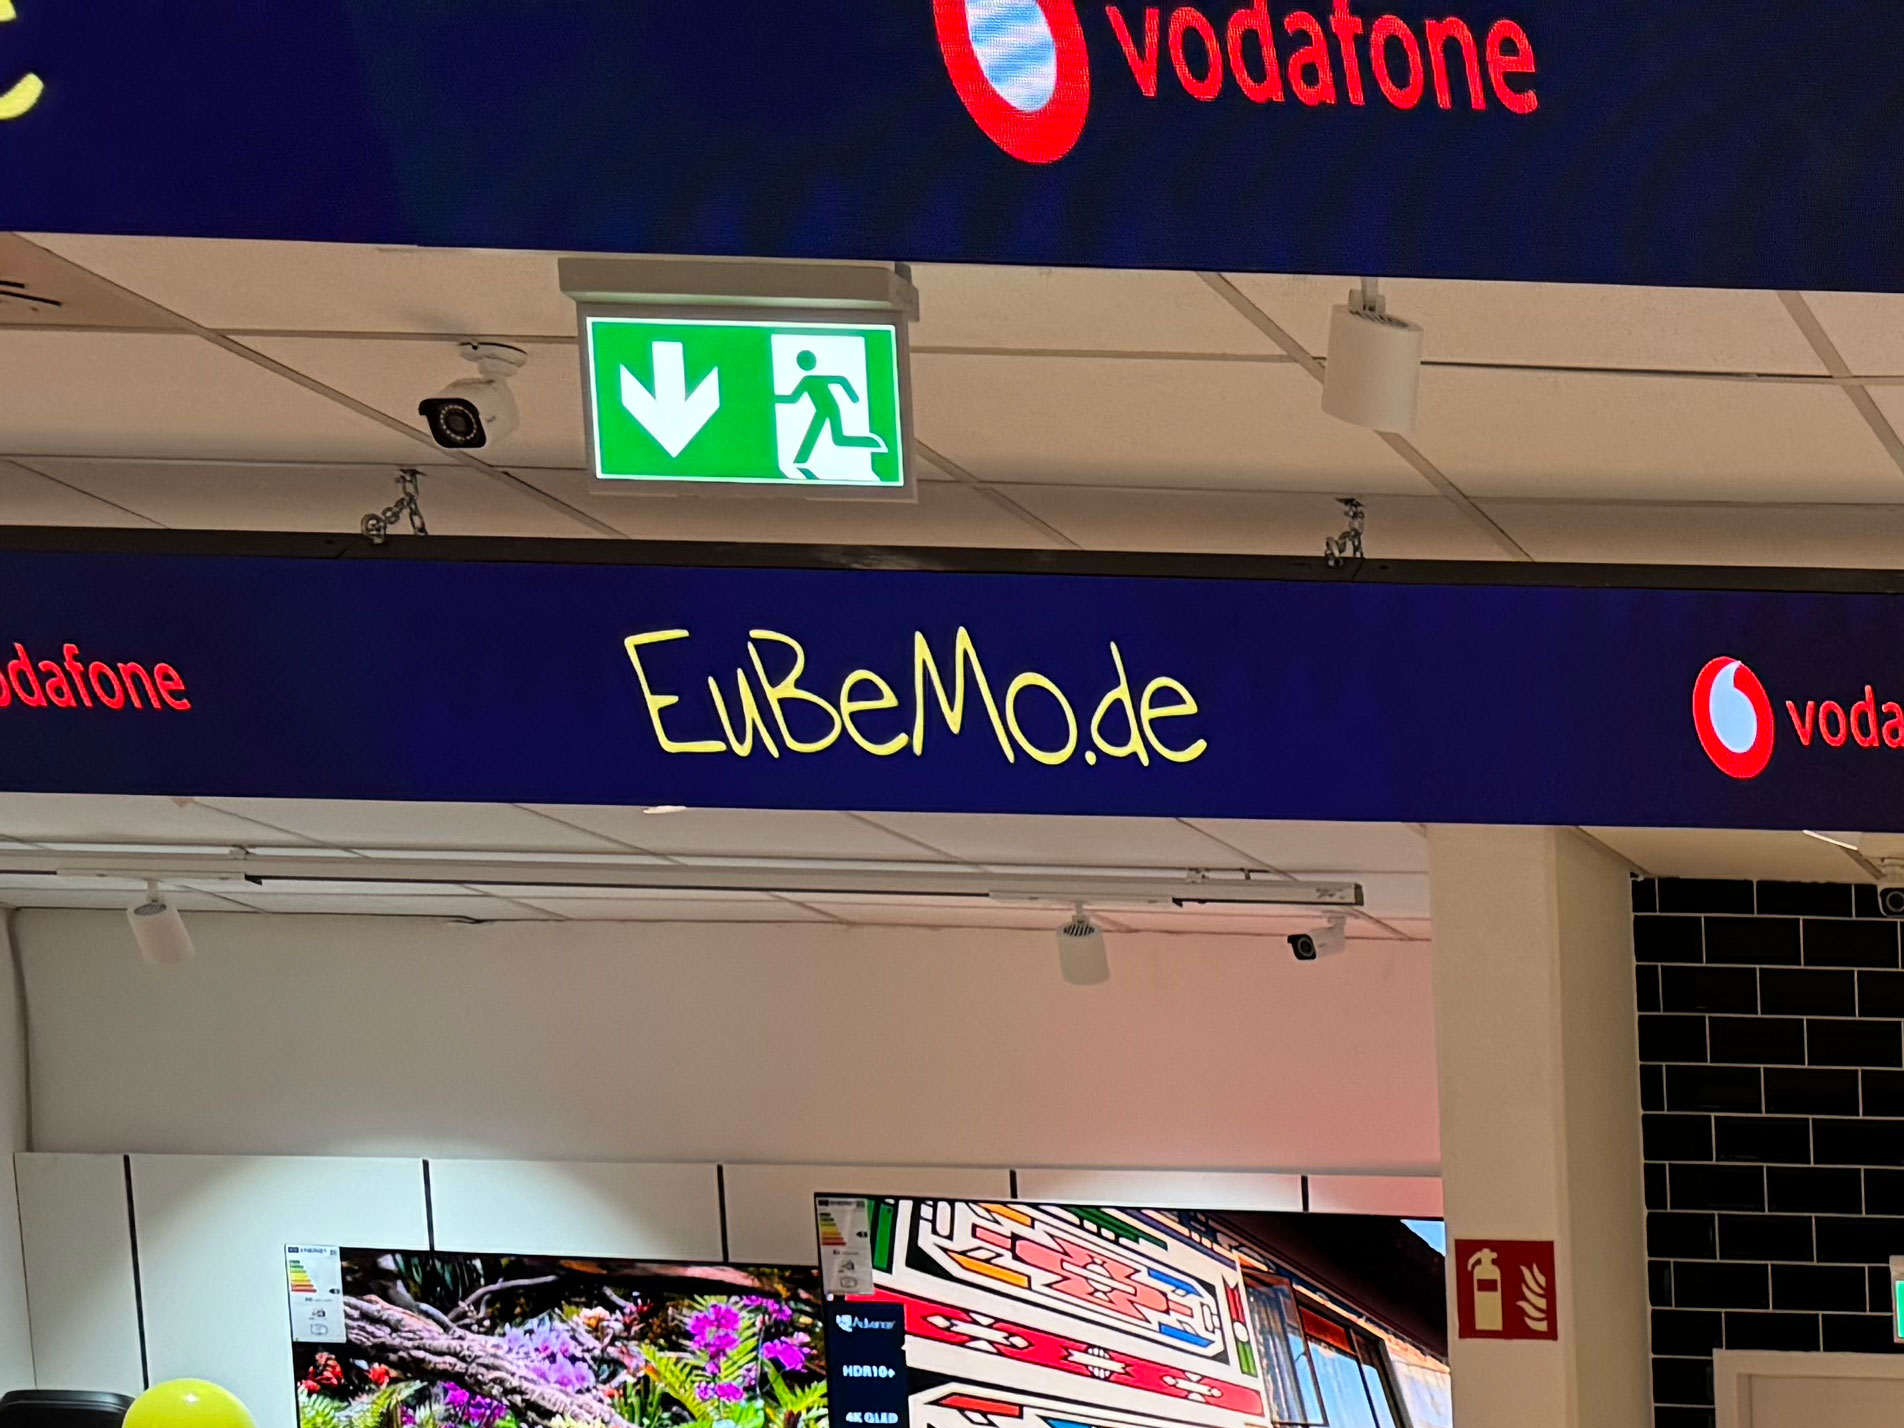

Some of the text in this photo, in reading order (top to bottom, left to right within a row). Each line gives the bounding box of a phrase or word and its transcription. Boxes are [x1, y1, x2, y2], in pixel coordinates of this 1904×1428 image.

[1106, 0, 1538, 114] vodafone
[0, 642, 191, 710] dafone
[621, 626, 1210, 768] EuBeMo.de
